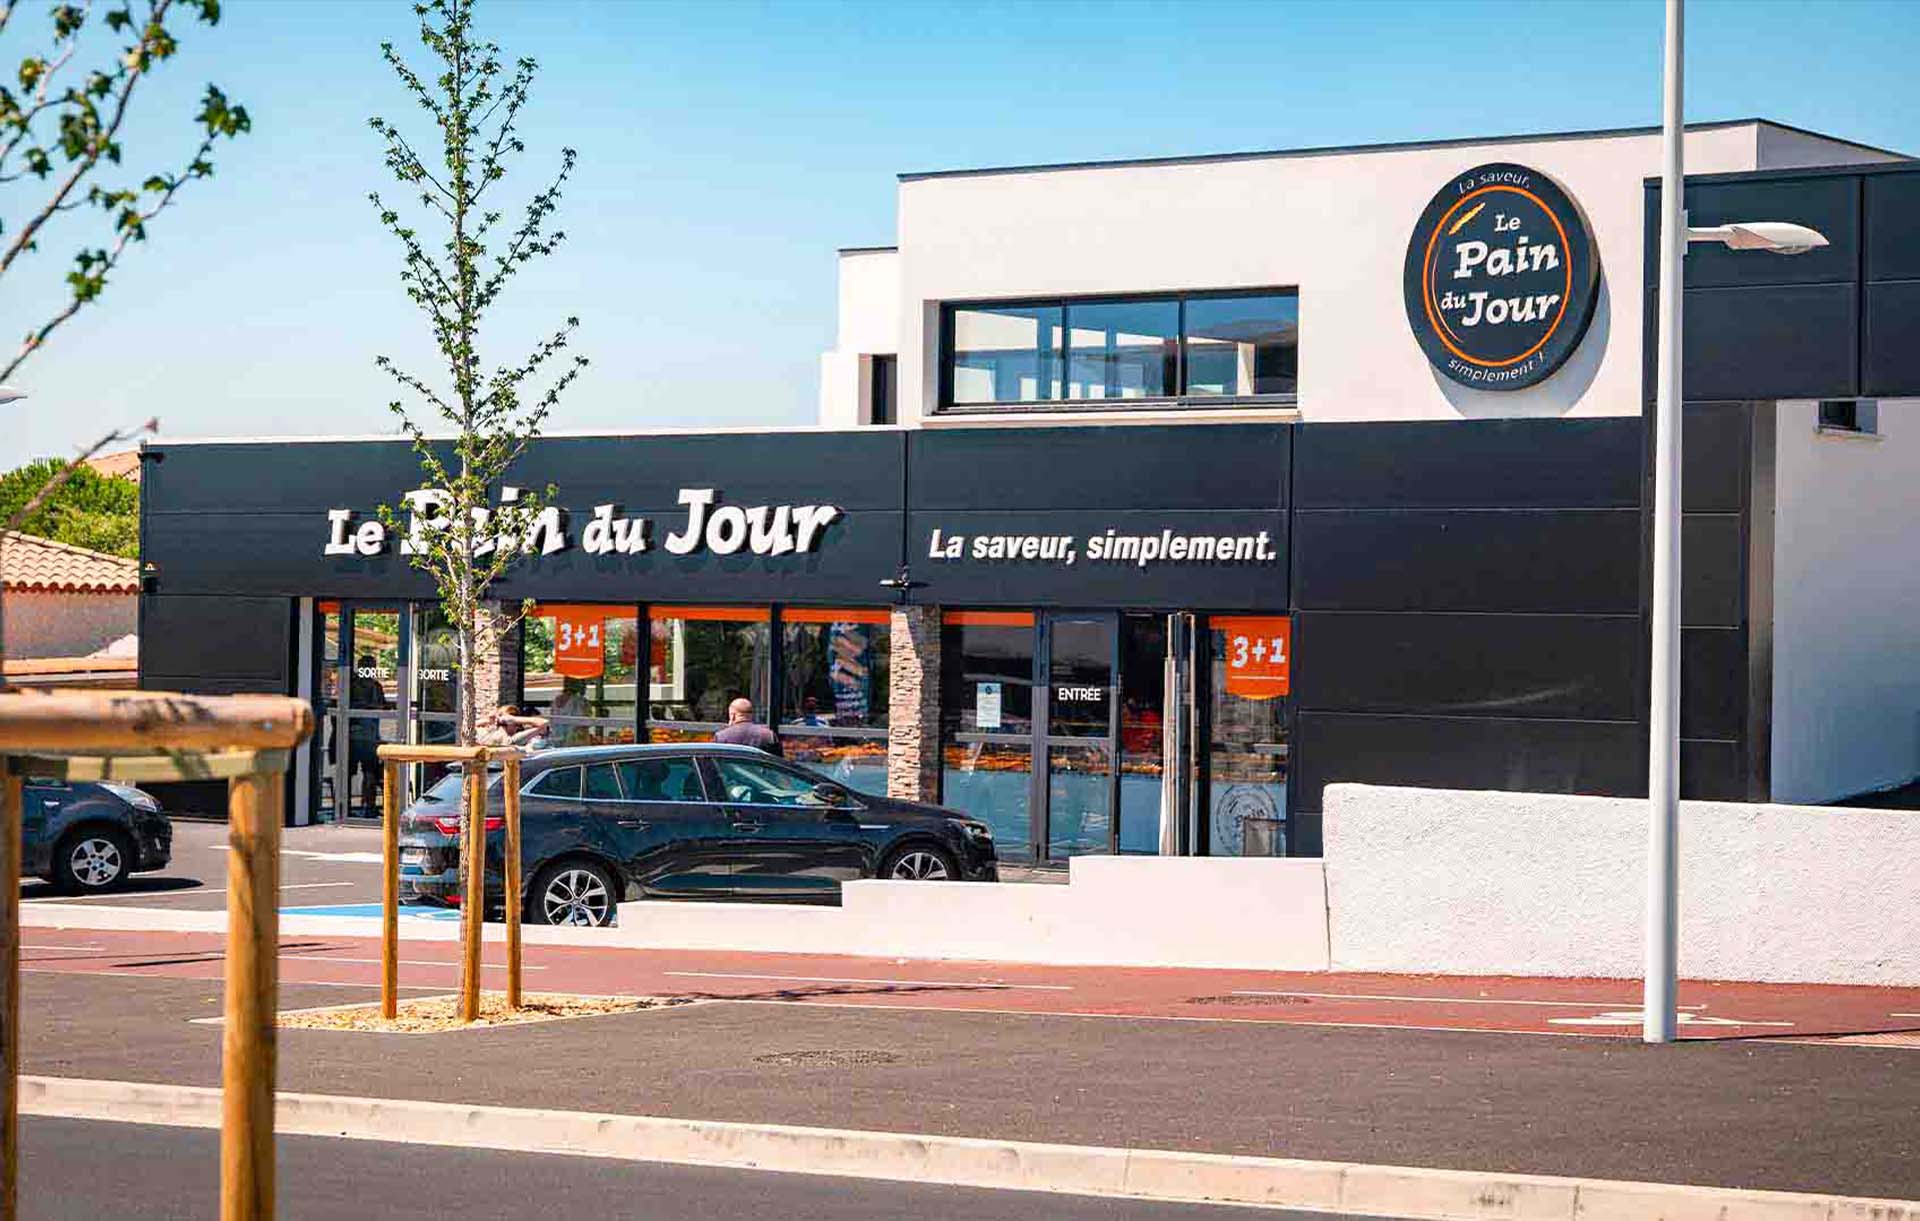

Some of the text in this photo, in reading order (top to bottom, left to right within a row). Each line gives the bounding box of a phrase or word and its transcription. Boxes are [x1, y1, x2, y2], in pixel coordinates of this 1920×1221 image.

[1459, 179, 1474, 194] La
[1494, 214, 1521, 232] Le
[1453, 236, 1560, 279] Pain
[1440, 292, 1560, 326] du Jour
[1448, 358, 1534, 382] simplement
[324, 508, 388, 556] Le
[582, 503, 647, 556] du
[664, 488, 839, 557] Jour
[929, 529, 1277, 567] La saveur, simplement.
[558, 623, 600, 652] 3+1
[1231, 636, 1286, 668] 3+1
[358, 667, 390, 679] SORTIE
[418, 669, 449, 681] SORTIE
[1058, 684, 1101, 701] ENTRÉE
